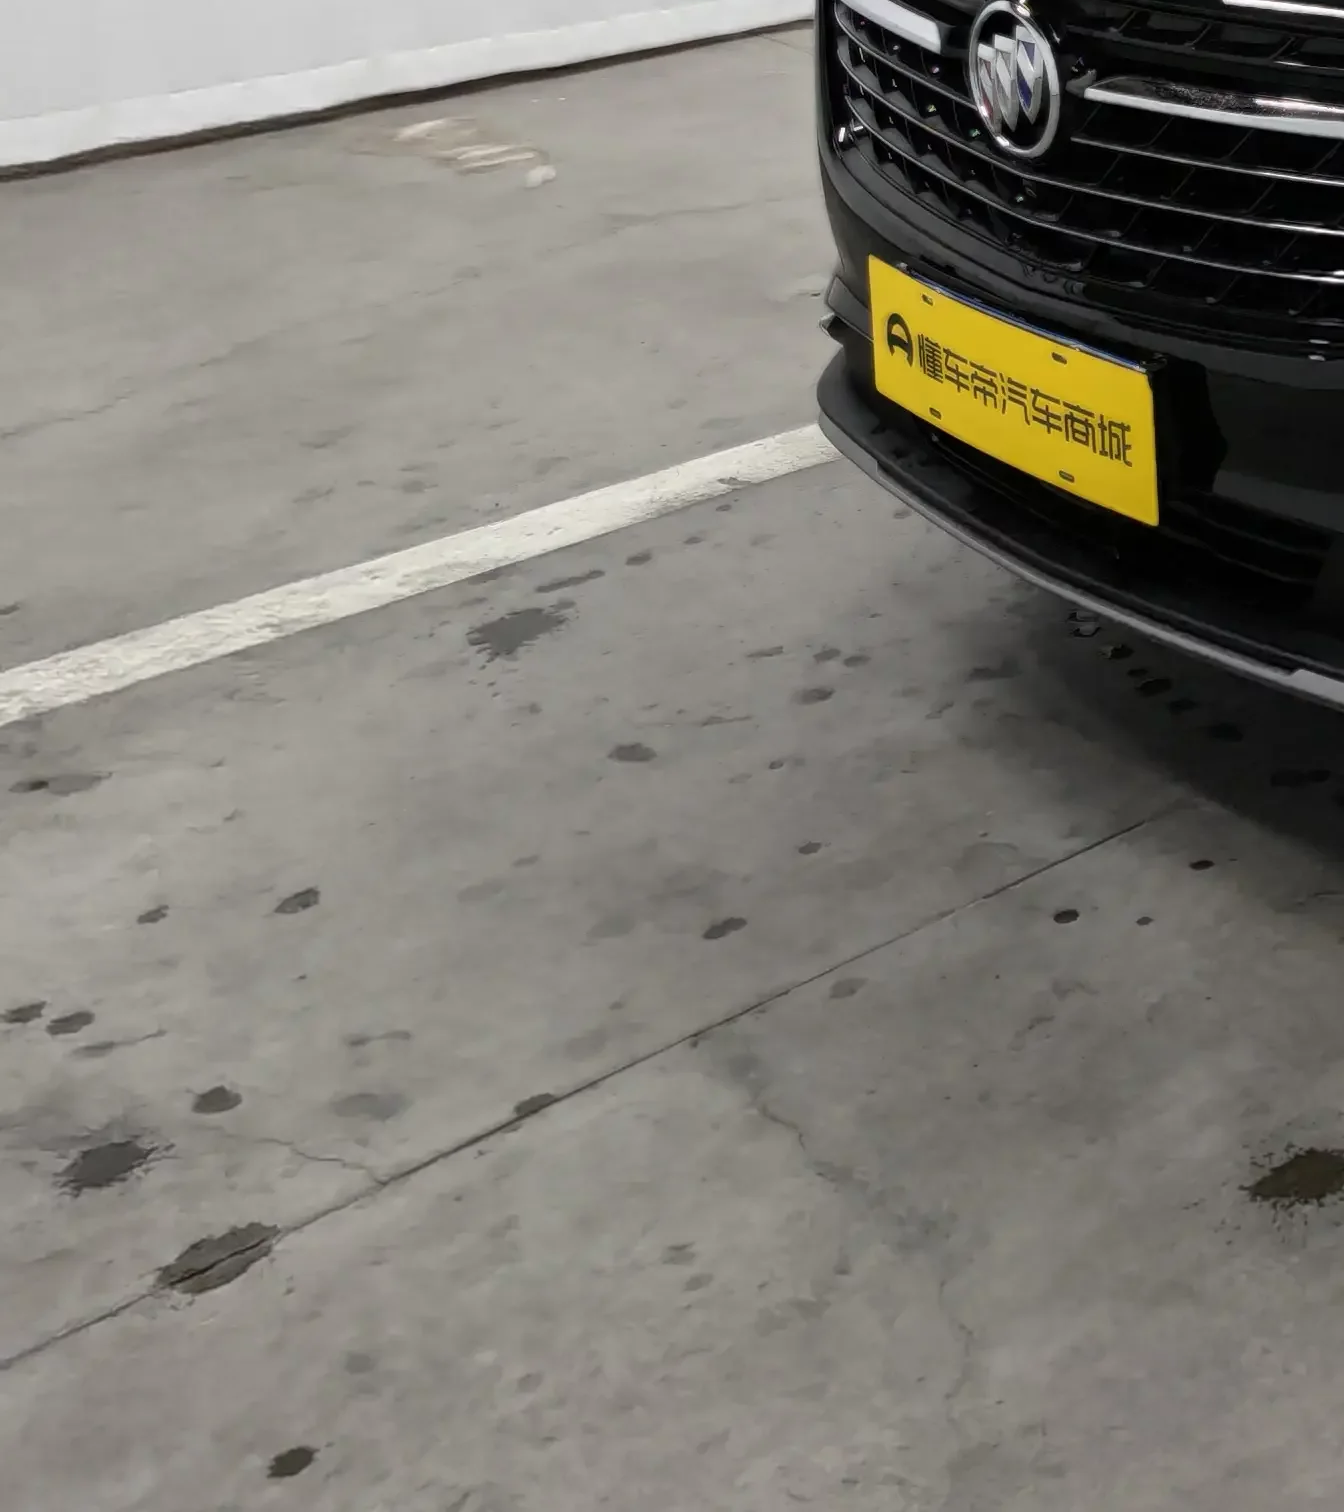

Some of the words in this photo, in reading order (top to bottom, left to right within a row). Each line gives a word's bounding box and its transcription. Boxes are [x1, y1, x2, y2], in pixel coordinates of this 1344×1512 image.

[917, 333, 1133, 467] 懂车帝汽车商城
